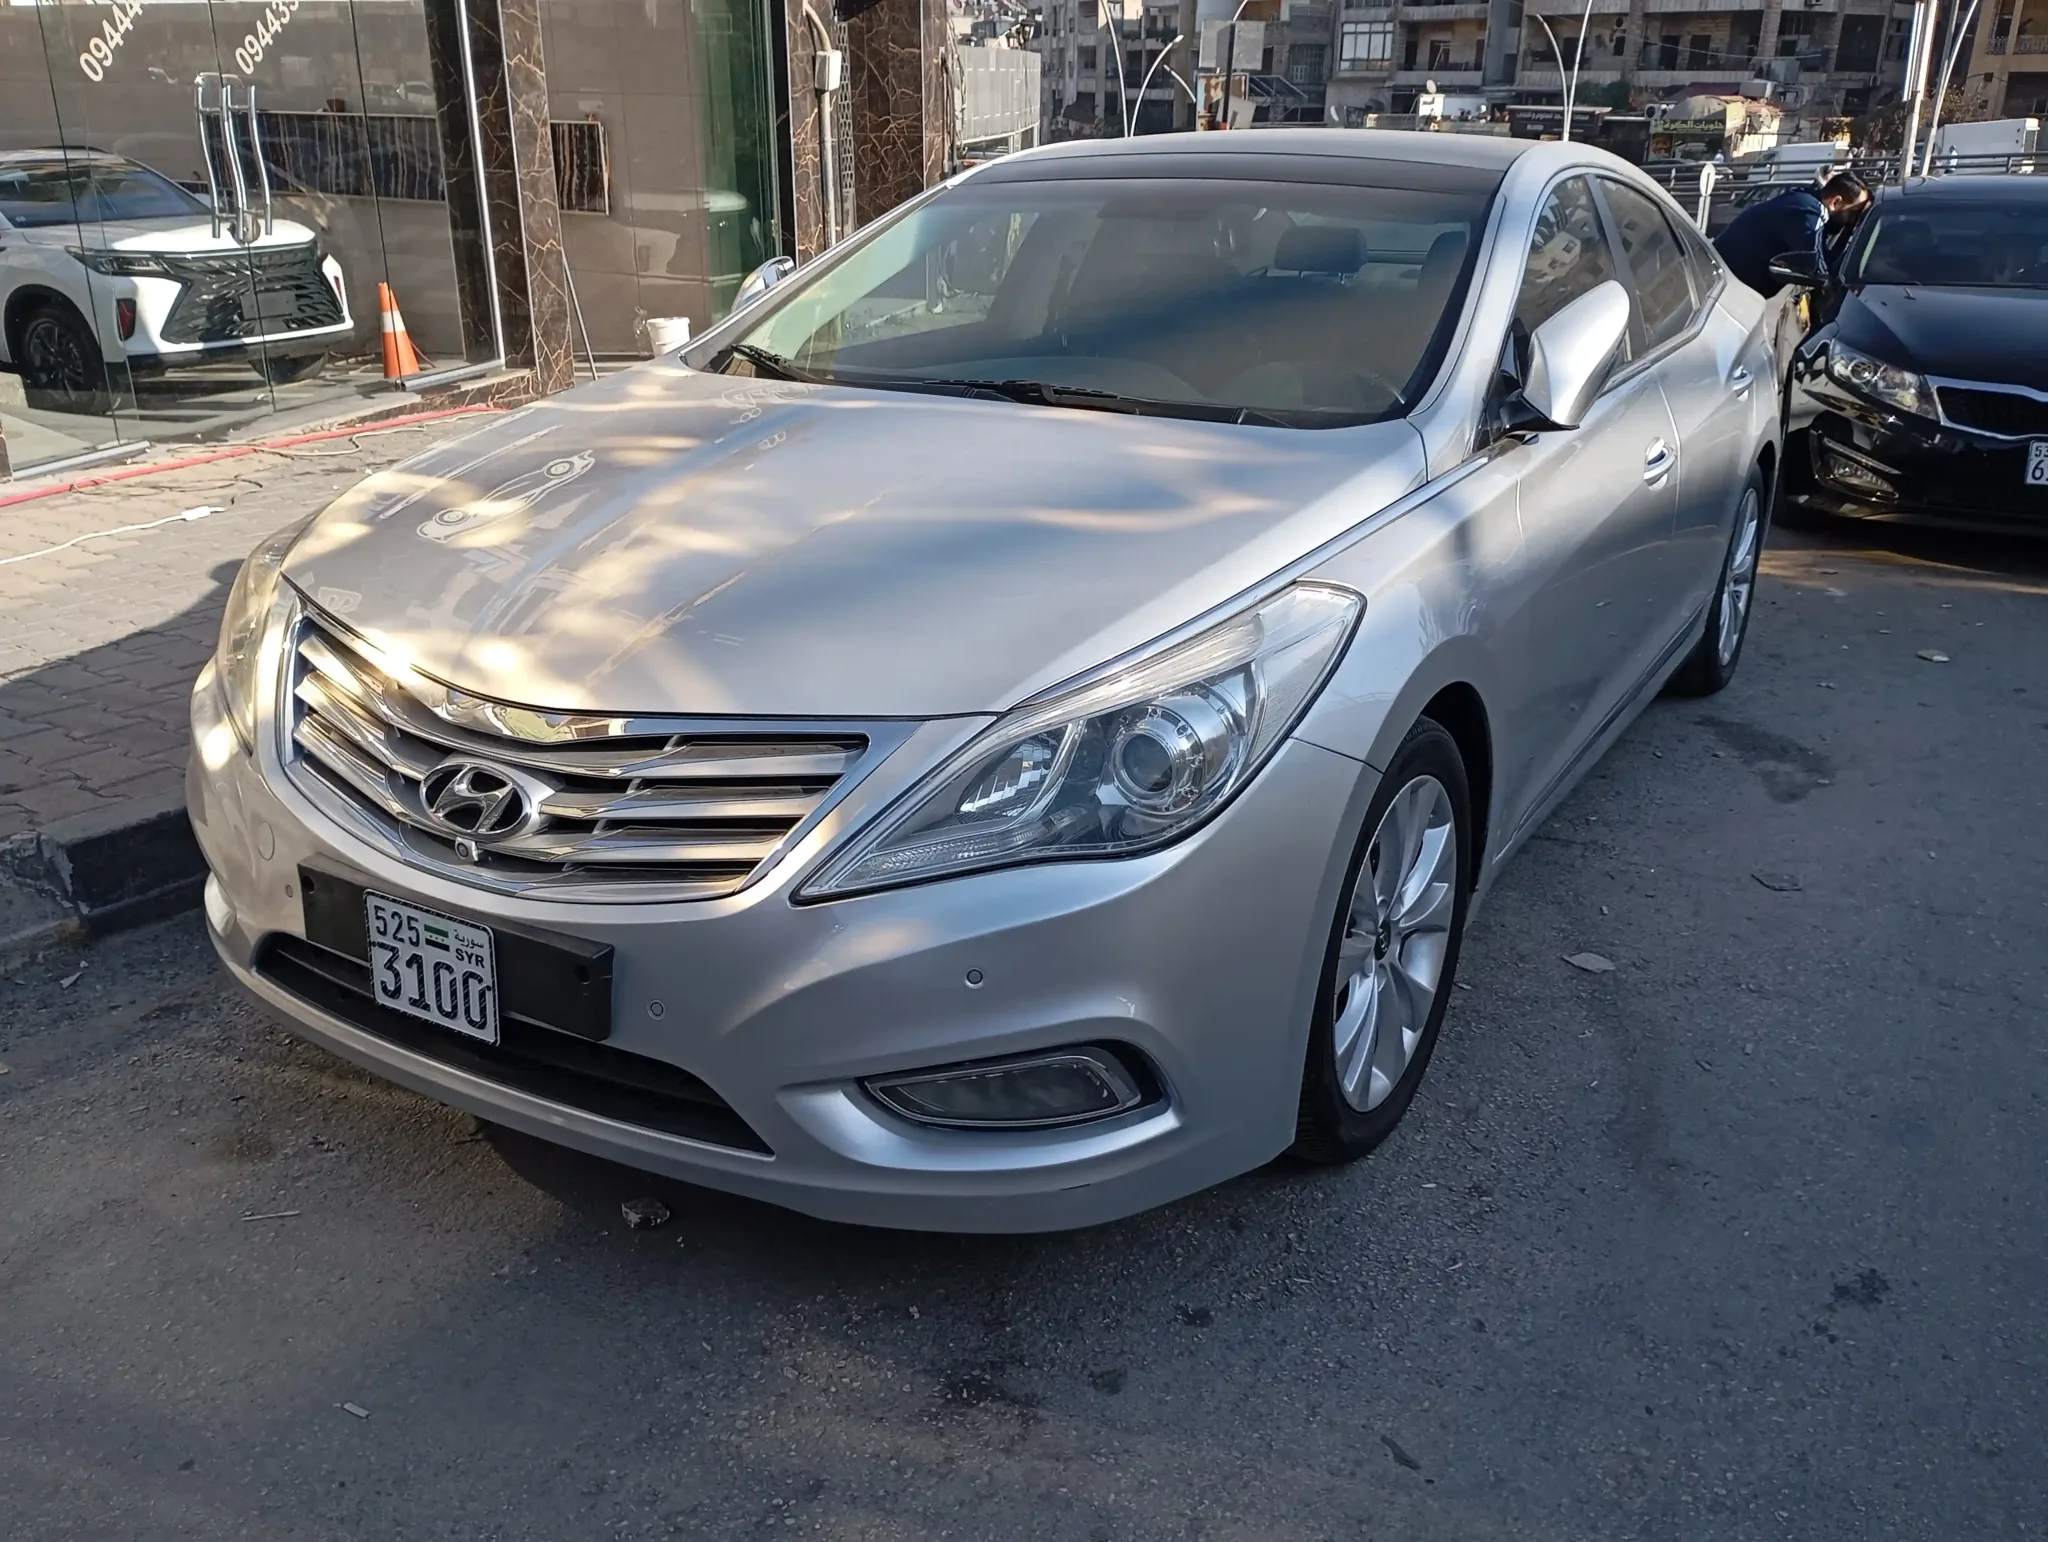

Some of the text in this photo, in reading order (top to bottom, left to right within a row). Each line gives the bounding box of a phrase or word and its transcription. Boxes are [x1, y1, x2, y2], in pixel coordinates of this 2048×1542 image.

[374, 904, 420, 947] 525
[453, 928, 484, 949] سورية
[455, 948, 485, 969] SYR
[376, 941, 488, 1031] 3100
